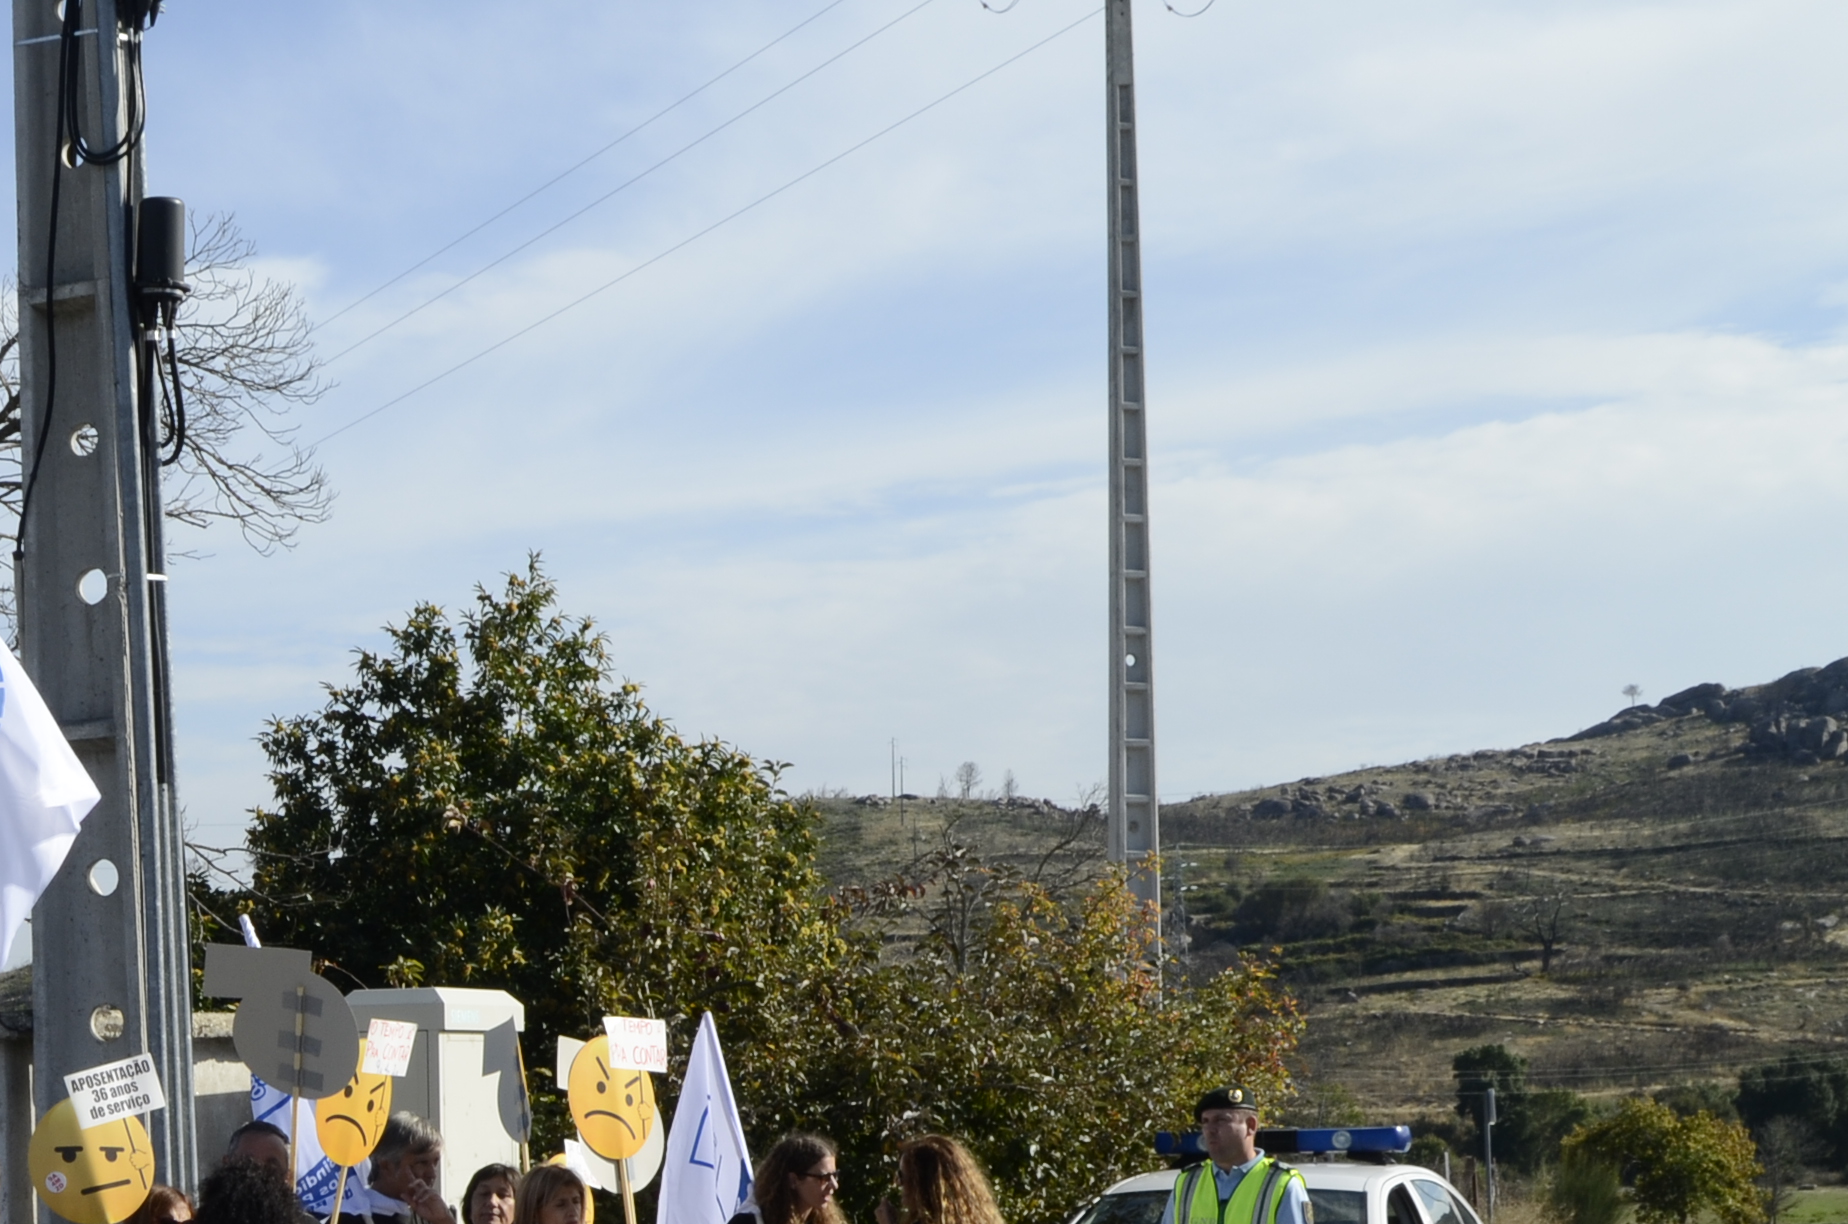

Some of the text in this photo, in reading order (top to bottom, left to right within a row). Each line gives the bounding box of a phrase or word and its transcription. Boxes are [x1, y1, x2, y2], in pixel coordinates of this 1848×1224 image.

[633, 1045, 667, 1067] CONTAR
[70, 1059, 150, 1093] APOSENTAÇÃO
[91, 1081, 139, 1103] 36 anos
[90, 1093, 151, 1120] de serviço
